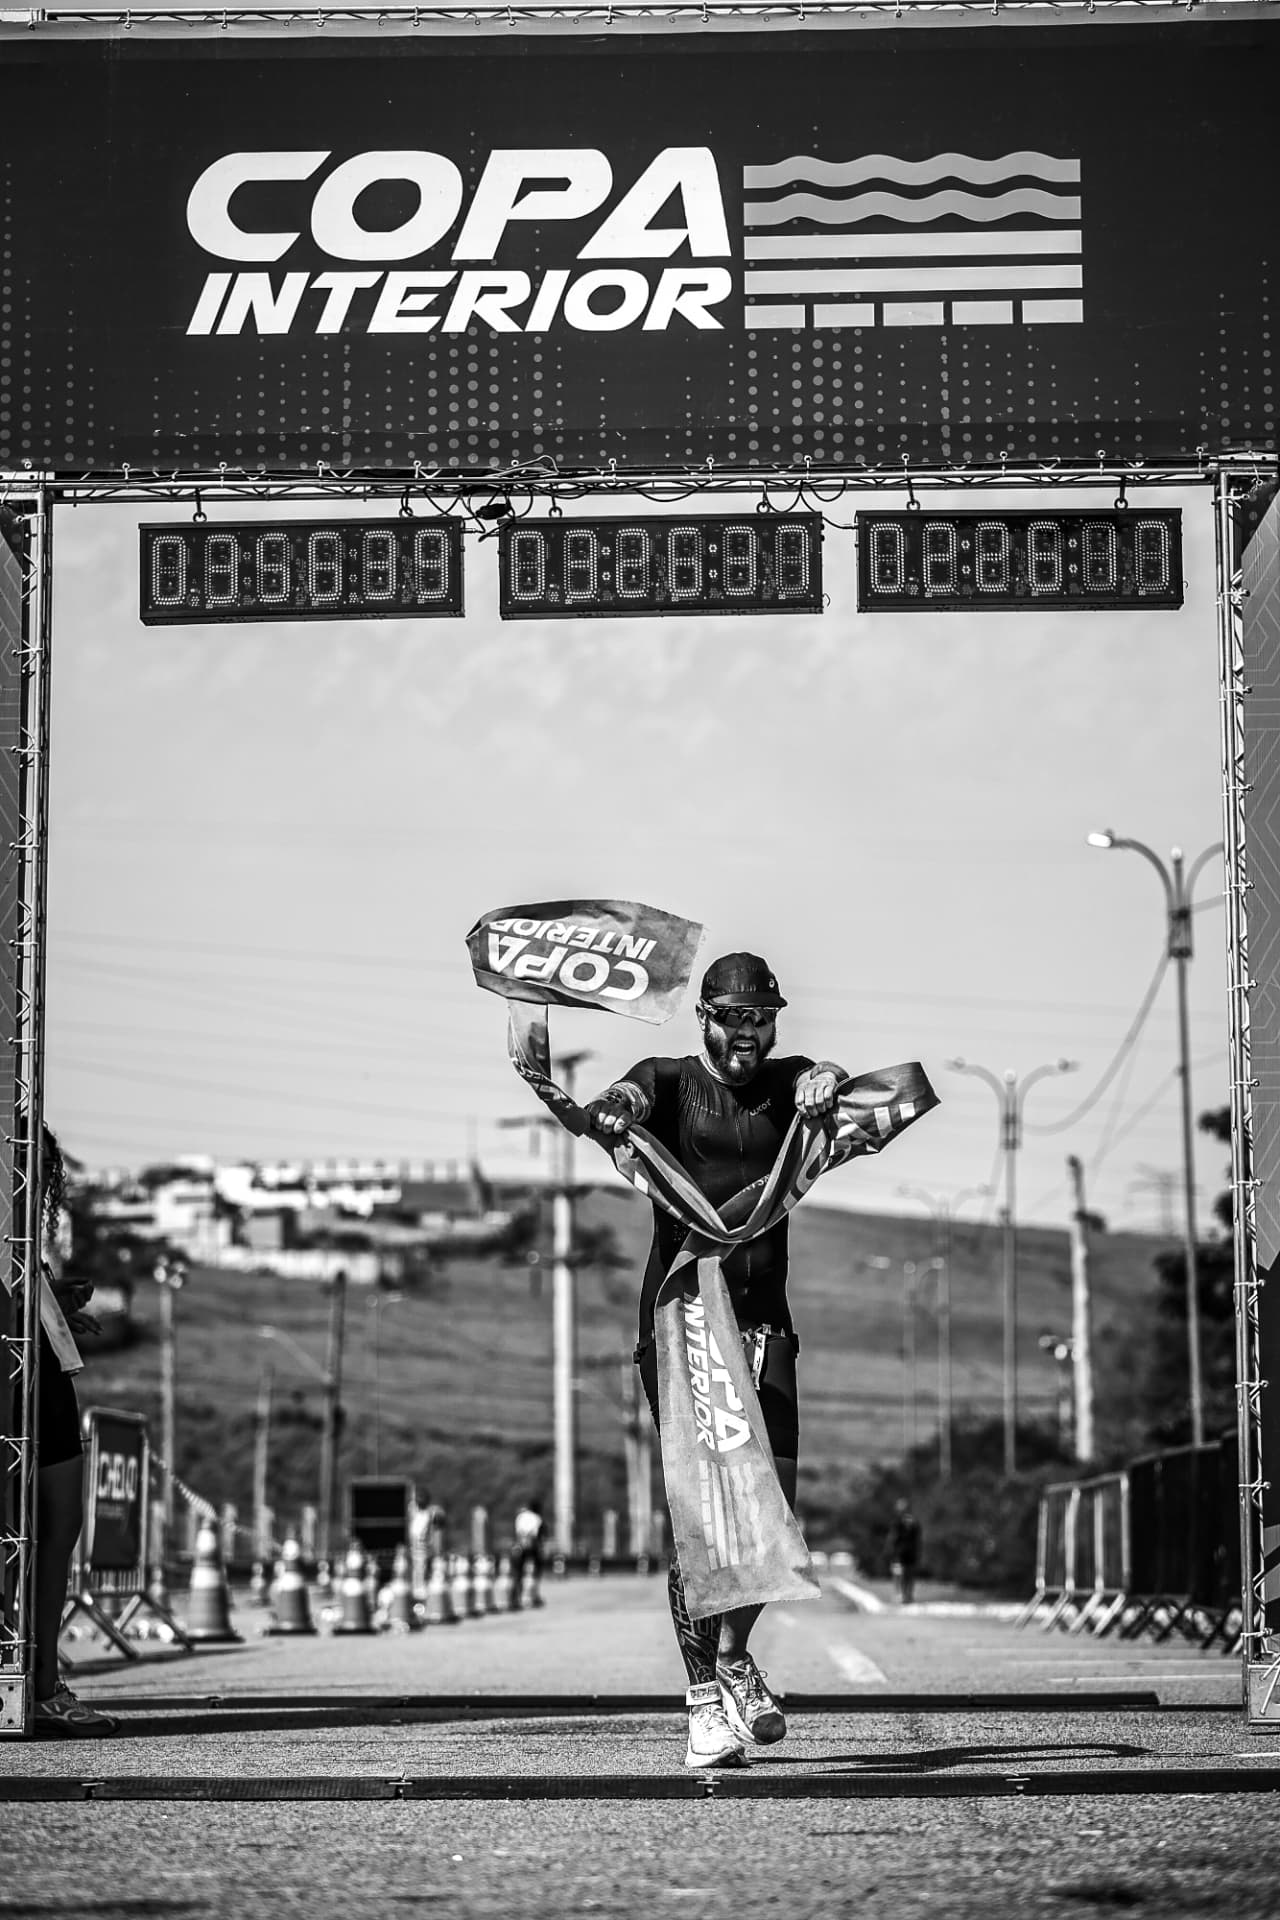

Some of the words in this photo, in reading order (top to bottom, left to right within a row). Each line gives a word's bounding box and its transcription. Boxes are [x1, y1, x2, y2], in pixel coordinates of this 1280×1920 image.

[187, 147, 731, 261] COPA
[186, 268, 732, 335] INTERIOR
[488, 932, 649, 1000] COPA
